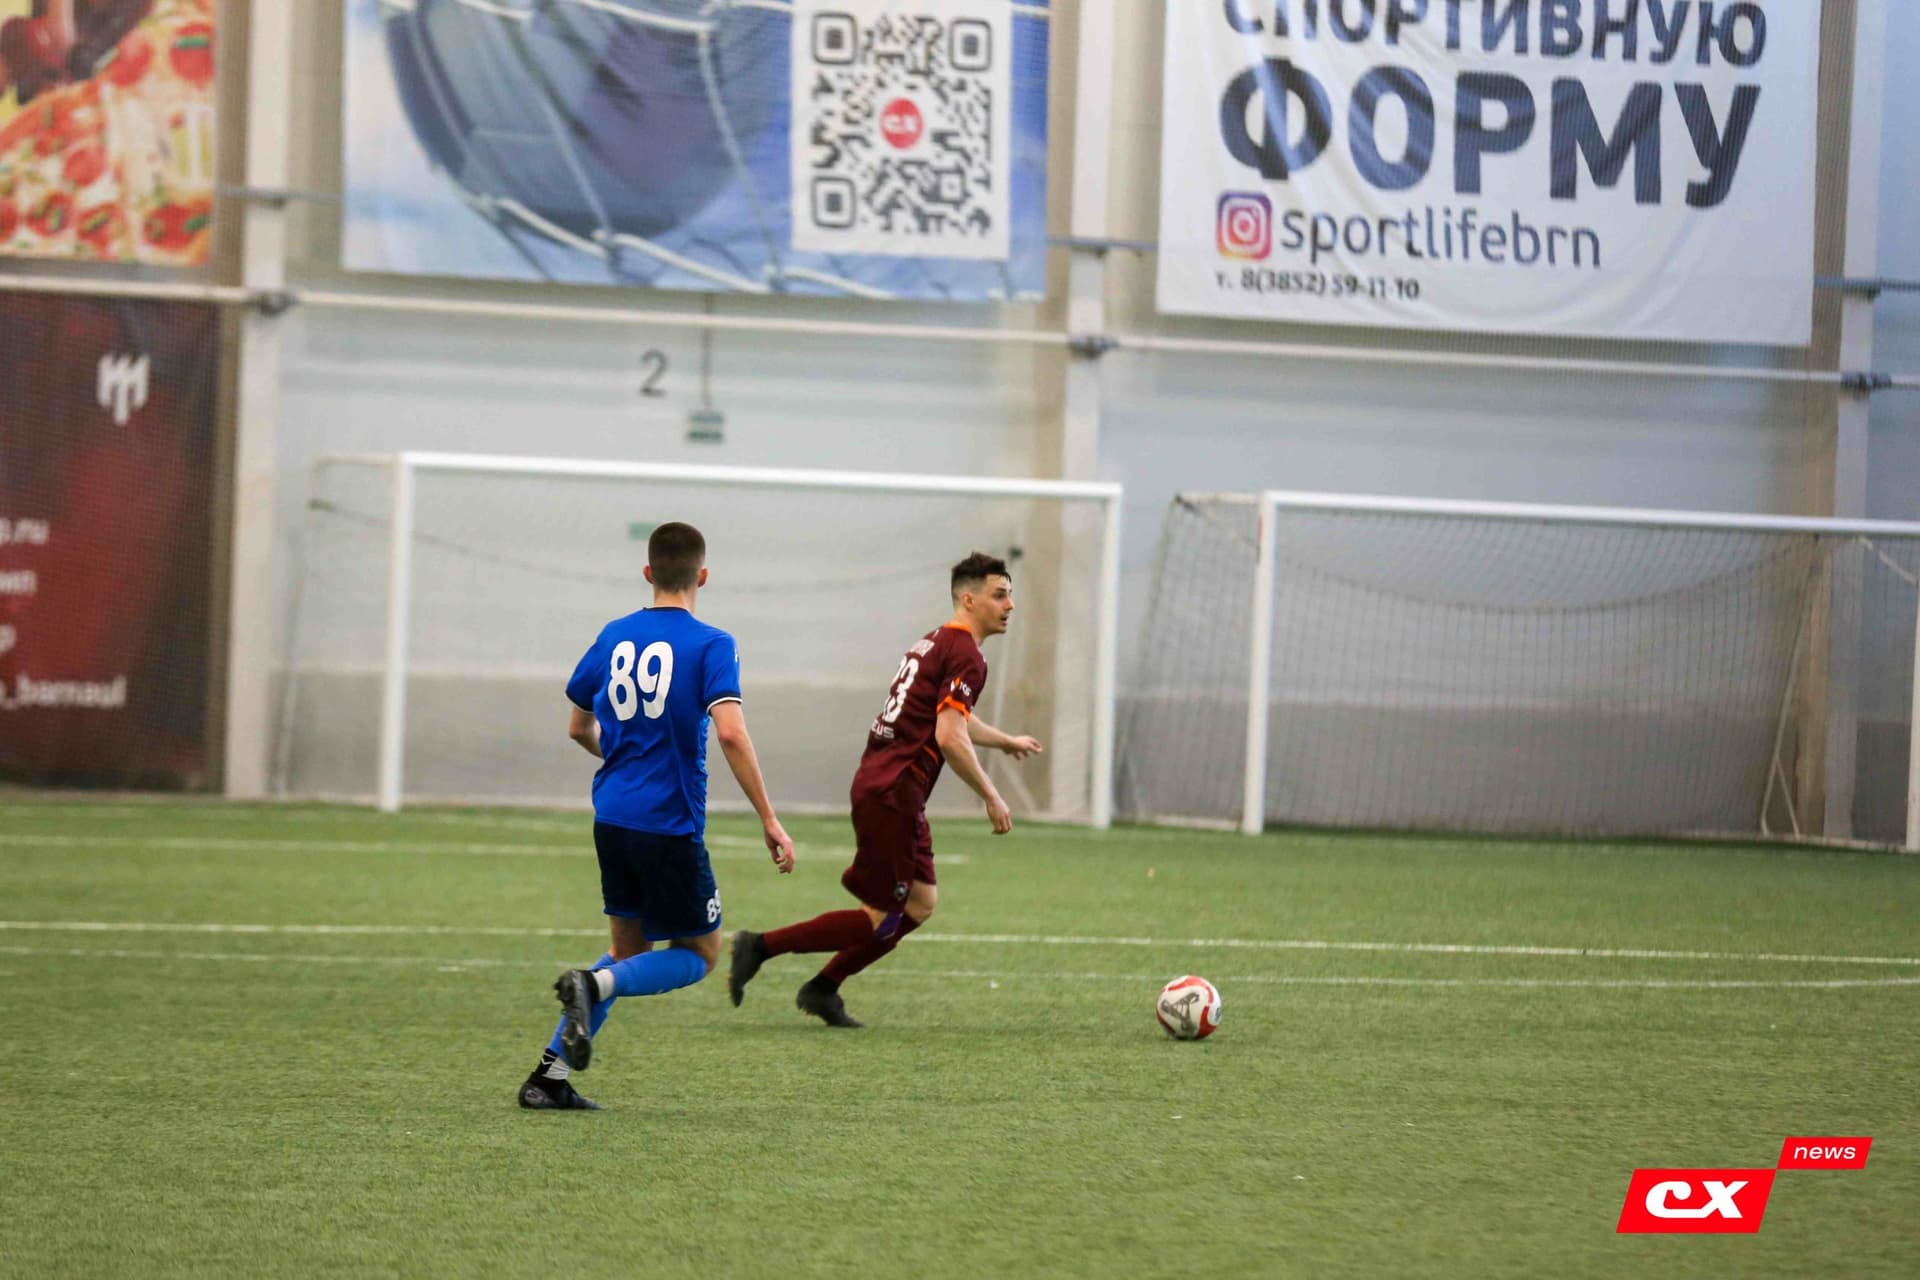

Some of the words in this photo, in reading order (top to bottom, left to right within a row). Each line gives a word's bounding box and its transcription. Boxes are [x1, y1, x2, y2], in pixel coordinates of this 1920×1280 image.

[1219, 56, 1762, 208] ФОРМУ
[1282, 204, 1601, 269] sportlifebrn
[640, 348, 668, 397] 2
[607, 640, 675, 721] 89
